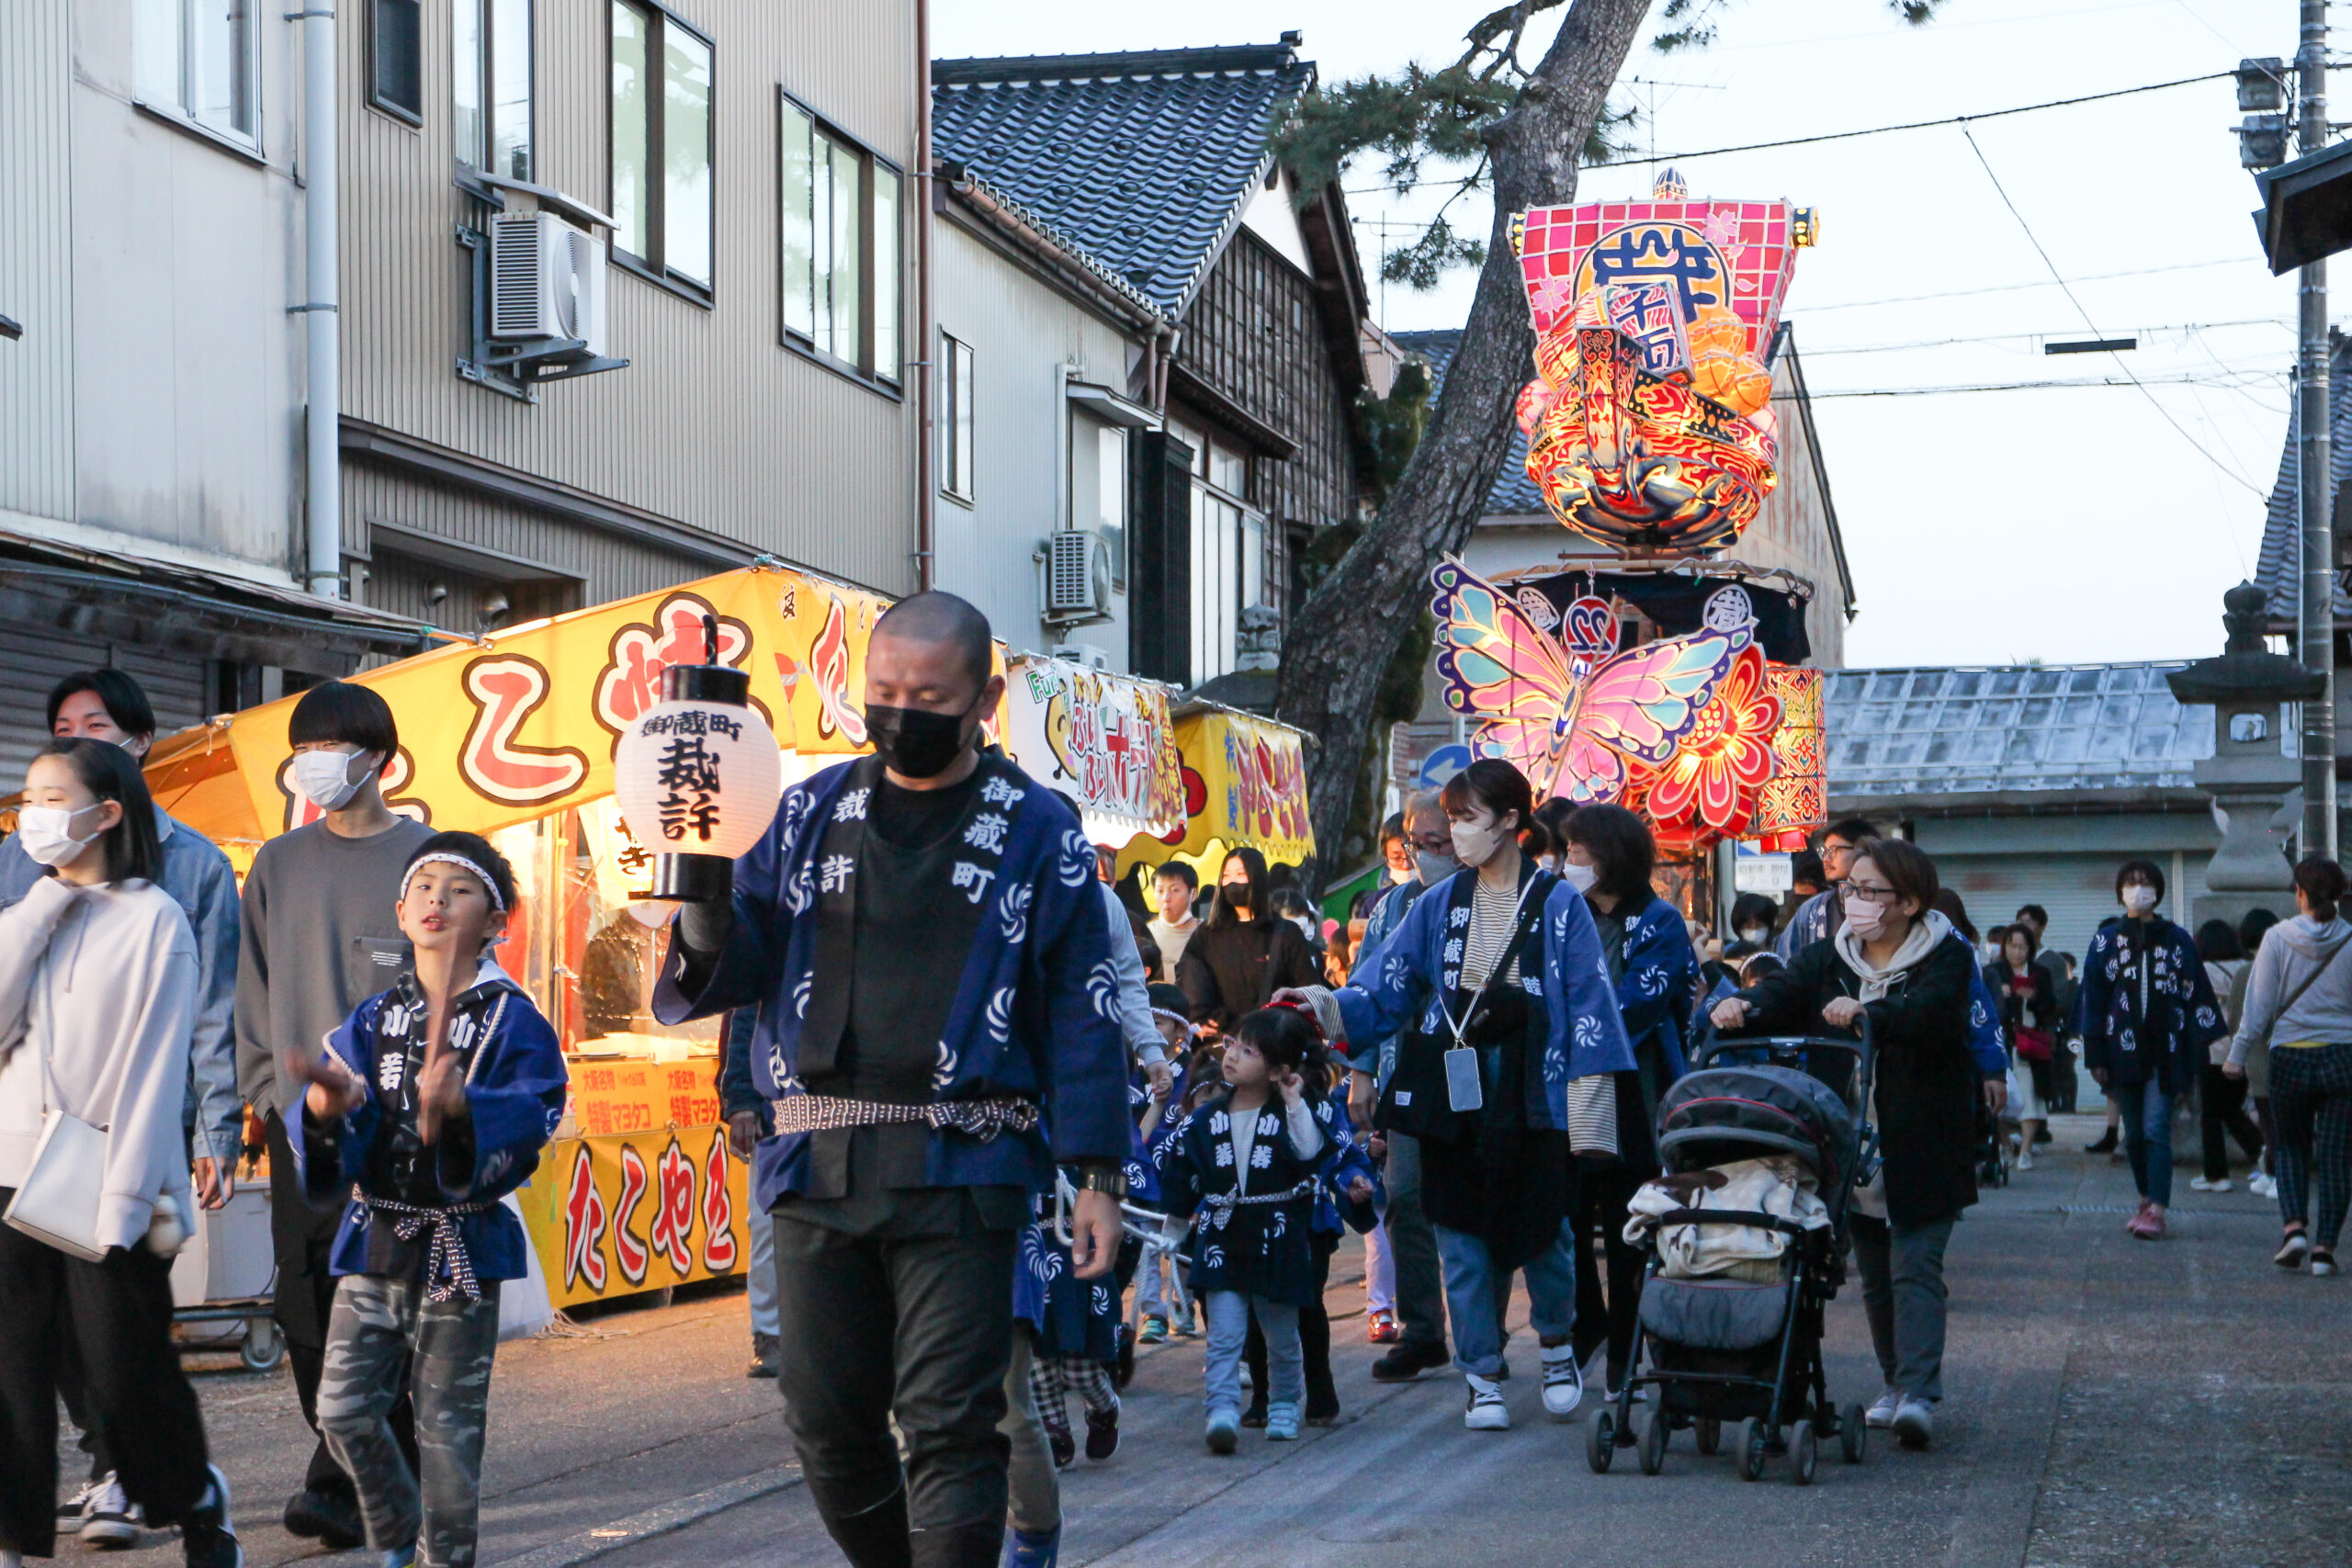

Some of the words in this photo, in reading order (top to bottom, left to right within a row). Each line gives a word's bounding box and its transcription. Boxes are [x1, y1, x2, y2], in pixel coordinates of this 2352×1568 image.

[642, 710, 742, 741] 御蔵町
[658, 737, 720, 841] 裁許
[820, 787, 872, 894] 裁許
[951, 776, 1025, 904] 御蔵町
[1443, 907, 1470, 990] 御蔵町
[379, 1004, 411, 1091] 小若
[586, 1100, 651, 1135] 特製マヨタコ
[670, 1094, 721, 1129] 特製マヨタ
